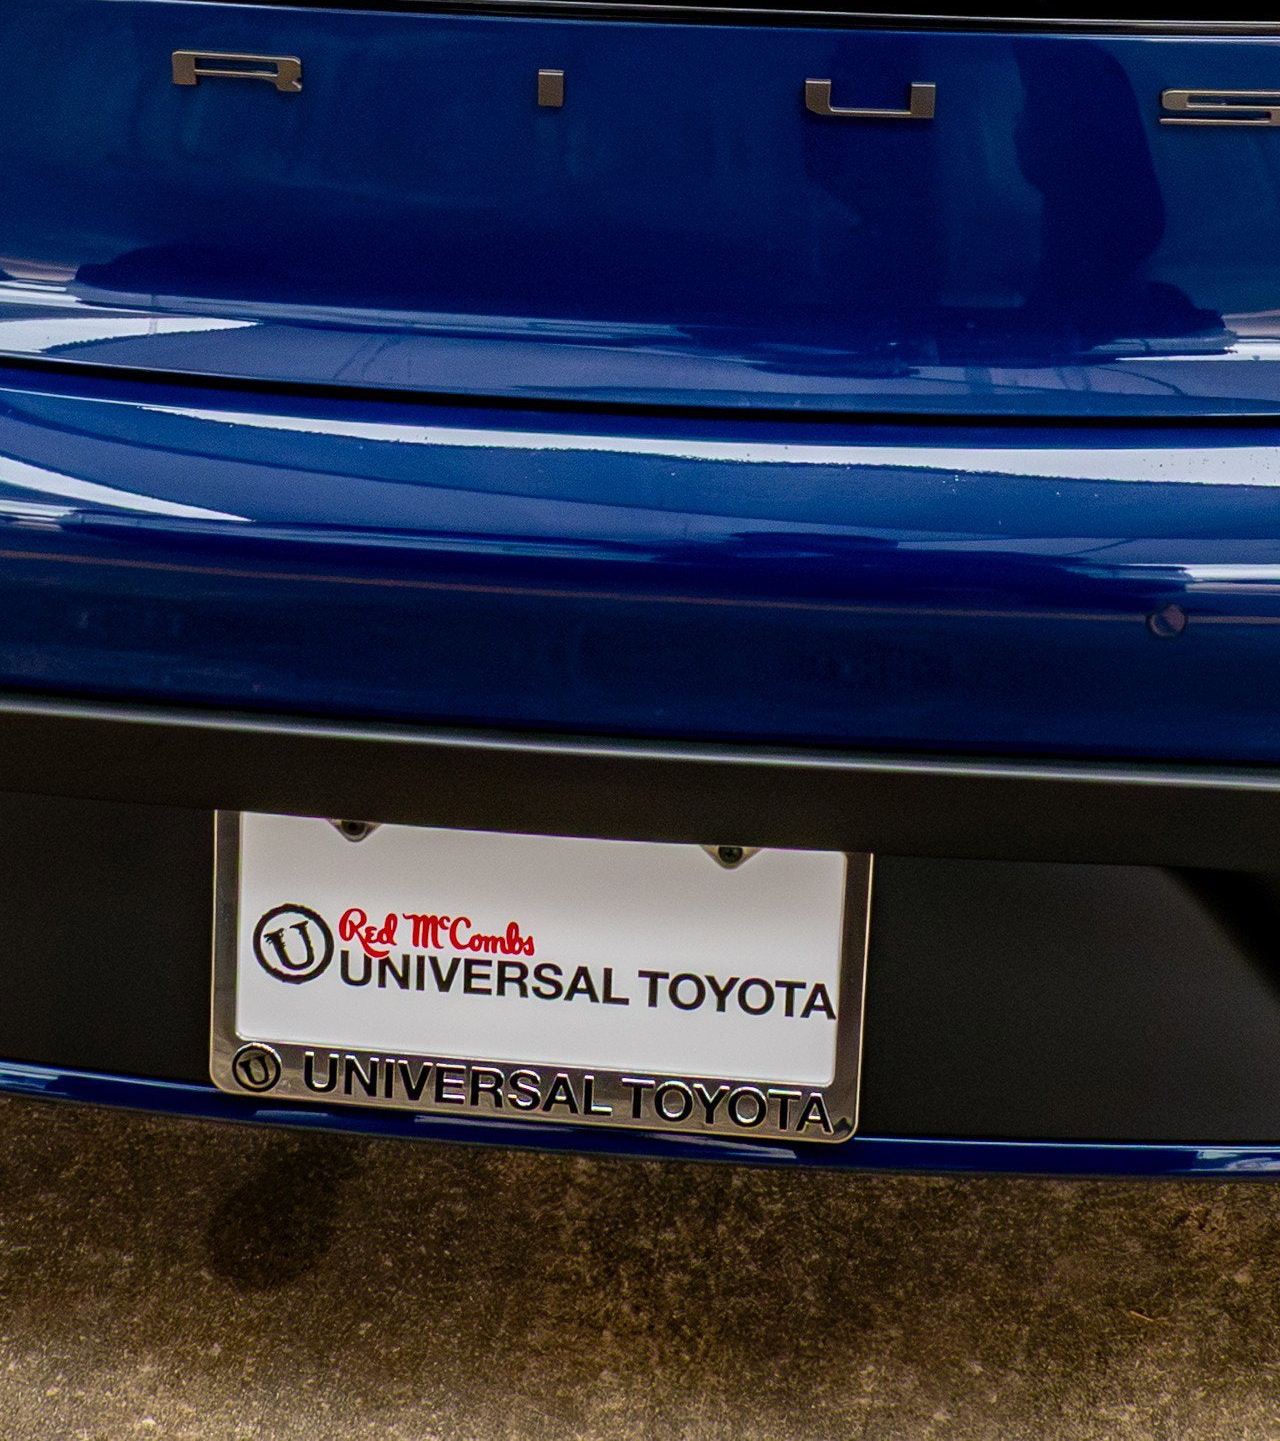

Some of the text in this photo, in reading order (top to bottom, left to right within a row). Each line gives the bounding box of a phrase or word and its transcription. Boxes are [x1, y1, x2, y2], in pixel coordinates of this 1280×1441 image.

[338, 908, 535, 958] Red McCombs
[339, 948, 837, 1020] UNIVERSAL TOYOTA
[302, 1051, 835, 1136] UNIVERSAL TOYOTA
